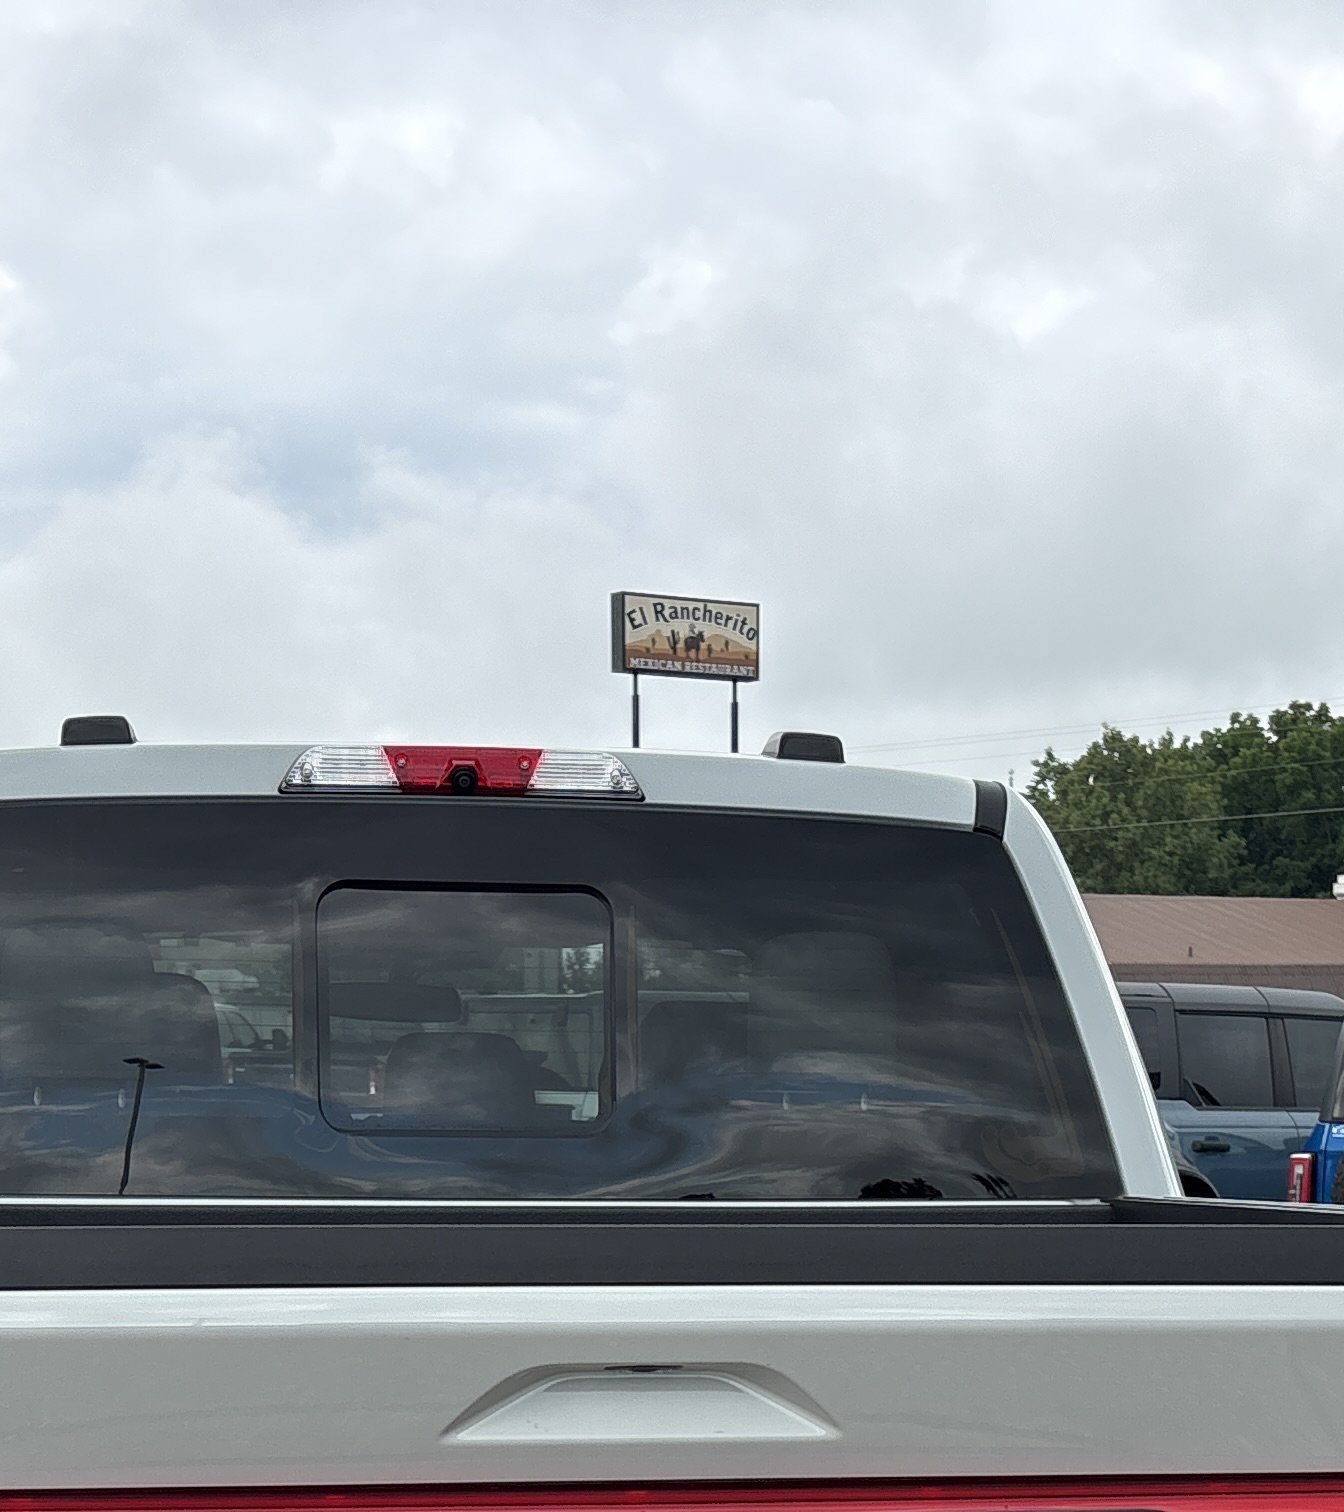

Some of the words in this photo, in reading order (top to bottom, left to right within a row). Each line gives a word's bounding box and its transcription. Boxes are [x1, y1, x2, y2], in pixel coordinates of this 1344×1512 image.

[626, 607, 648, 631] El
[652, 602, 757, 642] Rancherito
[629, 657, 682, 672] MEXICAN
[685, 661, 756, 677] RESTAURANT
